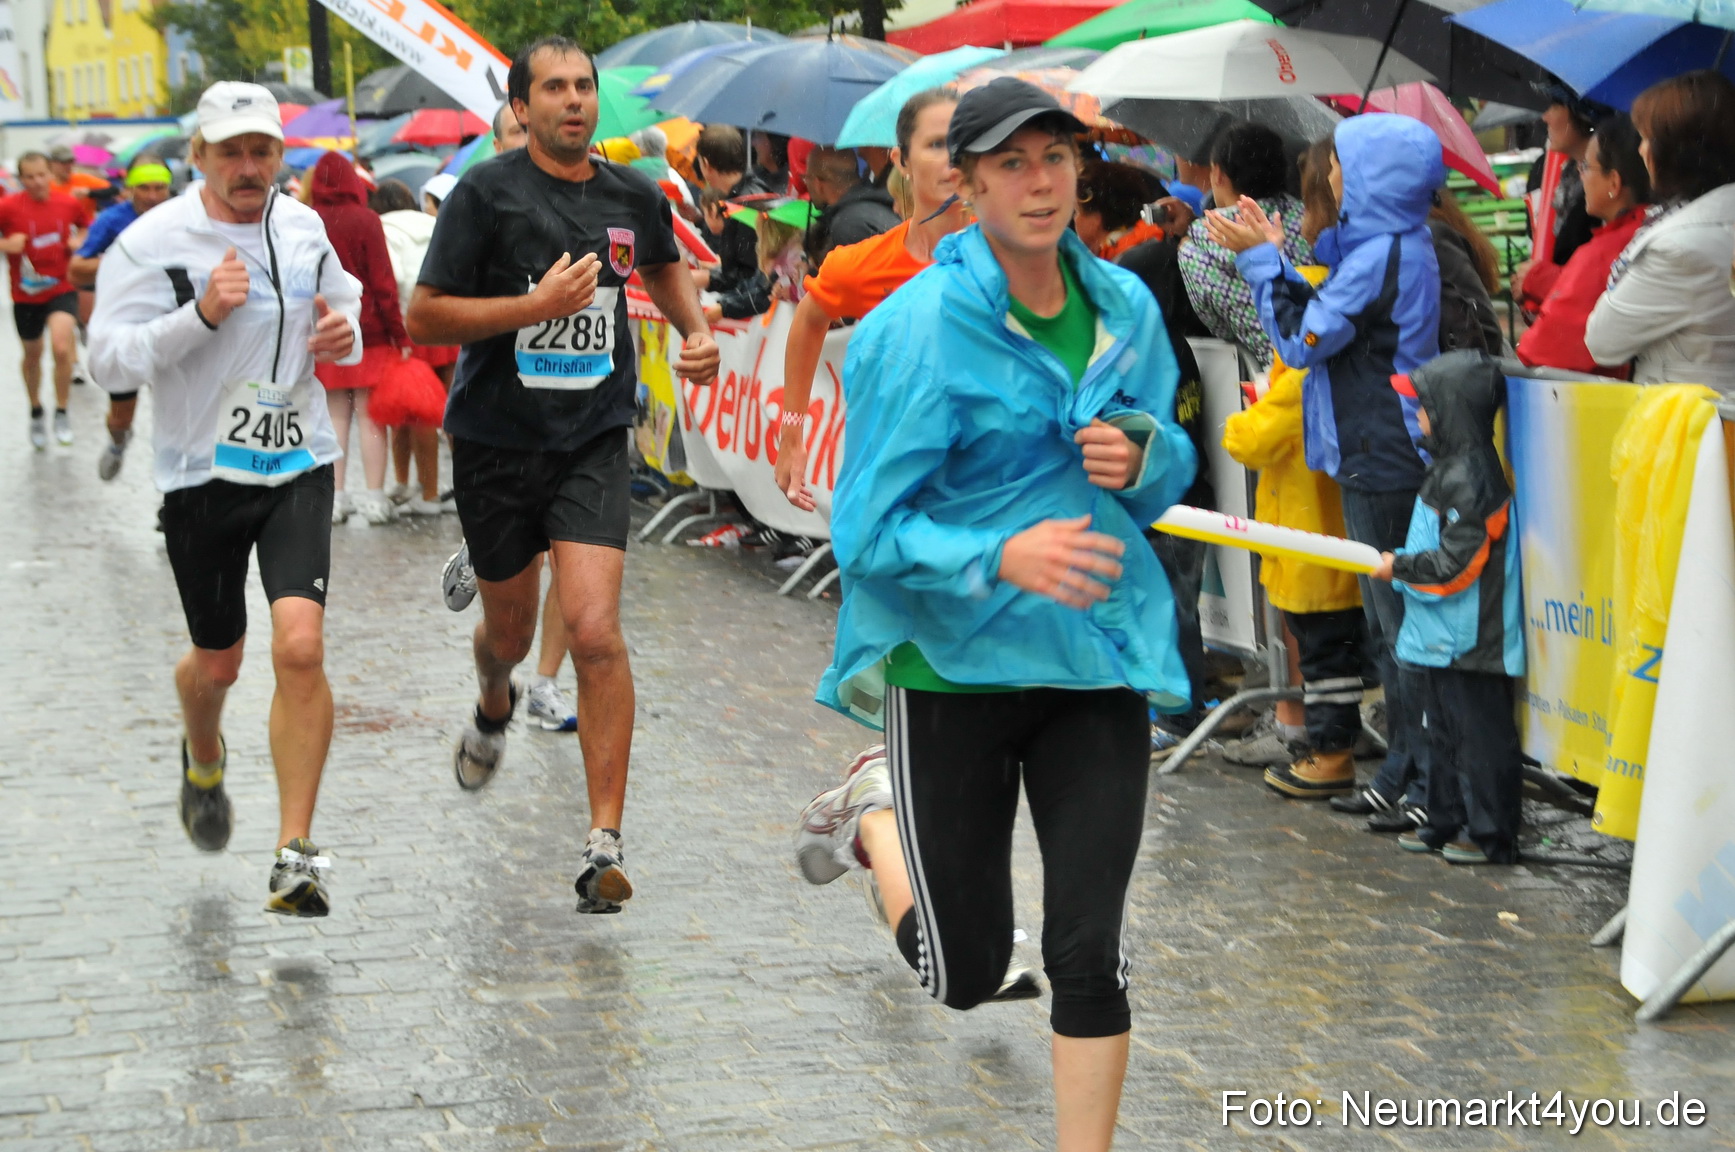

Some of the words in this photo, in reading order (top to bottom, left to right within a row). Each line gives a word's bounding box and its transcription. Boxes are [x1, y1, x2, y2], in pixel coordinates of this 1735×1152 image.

[527, 314, 607, 351] 2289
[534, 357, 592, 374] Christian
[228, 406, 304, 448] 2405
[1530, 590, 1595, 641] ...mein
[1601, 597, 1616, 647] Li
